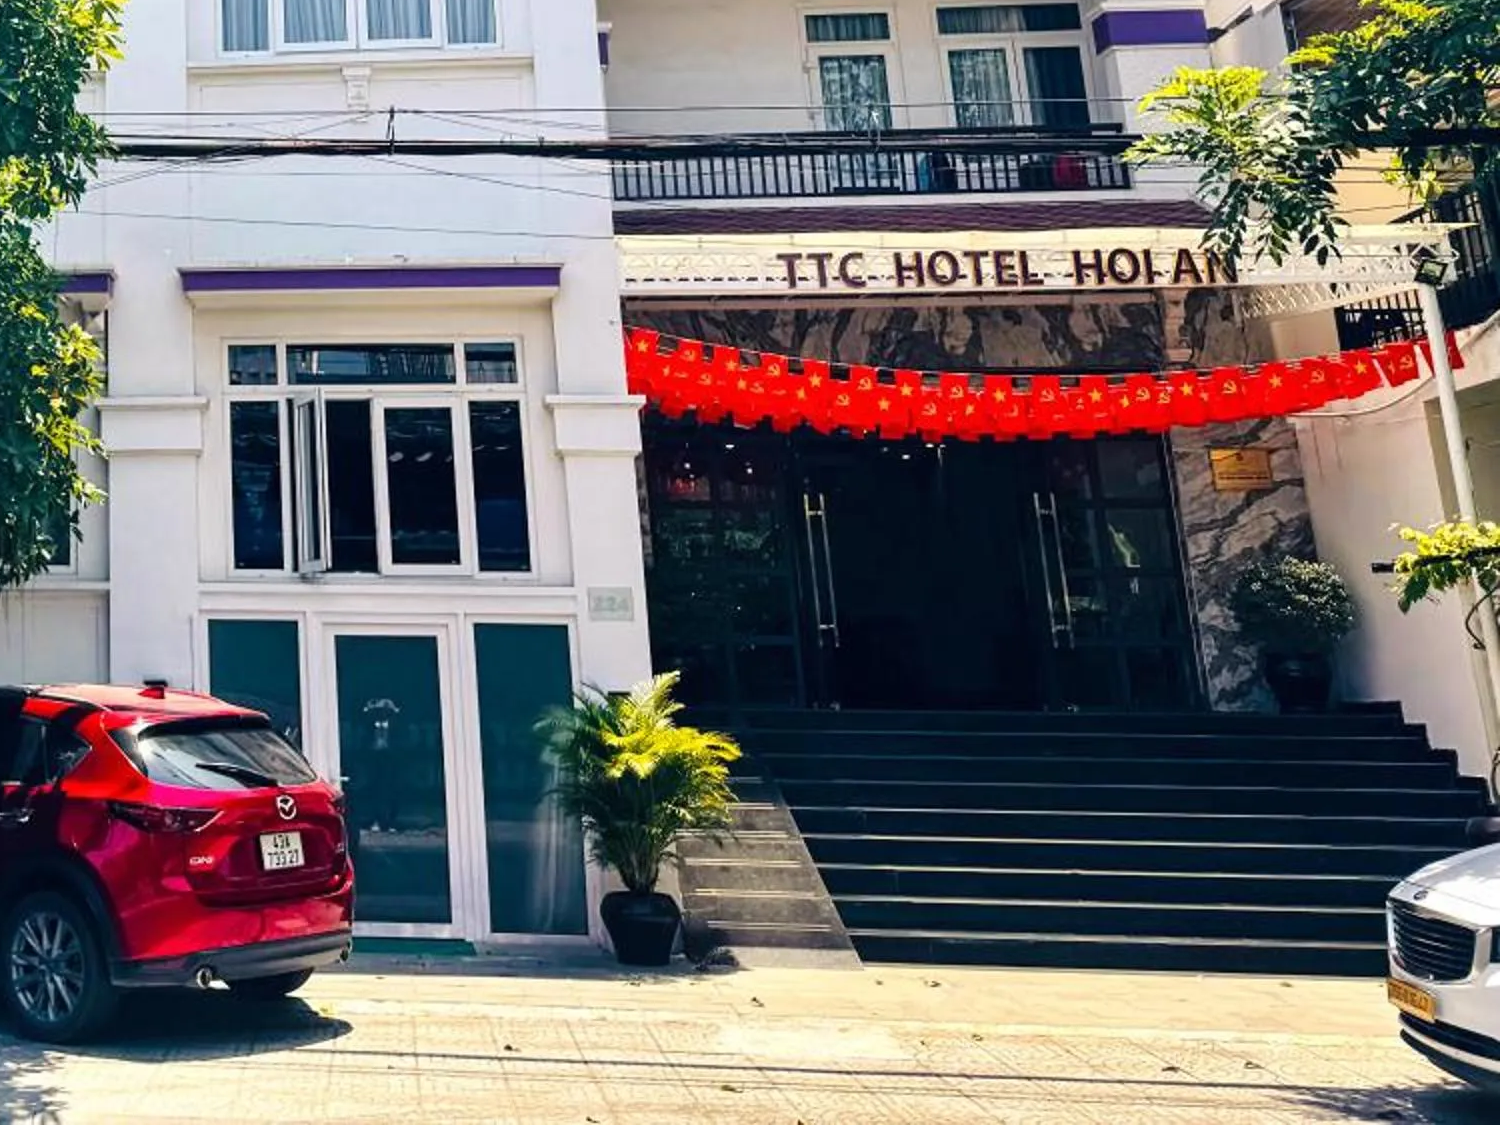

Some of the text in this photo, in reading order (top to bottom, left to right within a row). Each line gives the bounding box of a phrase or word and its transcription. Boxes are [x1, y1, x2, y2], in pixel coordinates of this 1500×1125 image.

[775, 251, 867, 289] TTC
[893, 249, 1045, 288] HOTEL
[1072, 248, 1155, 286] HOI
